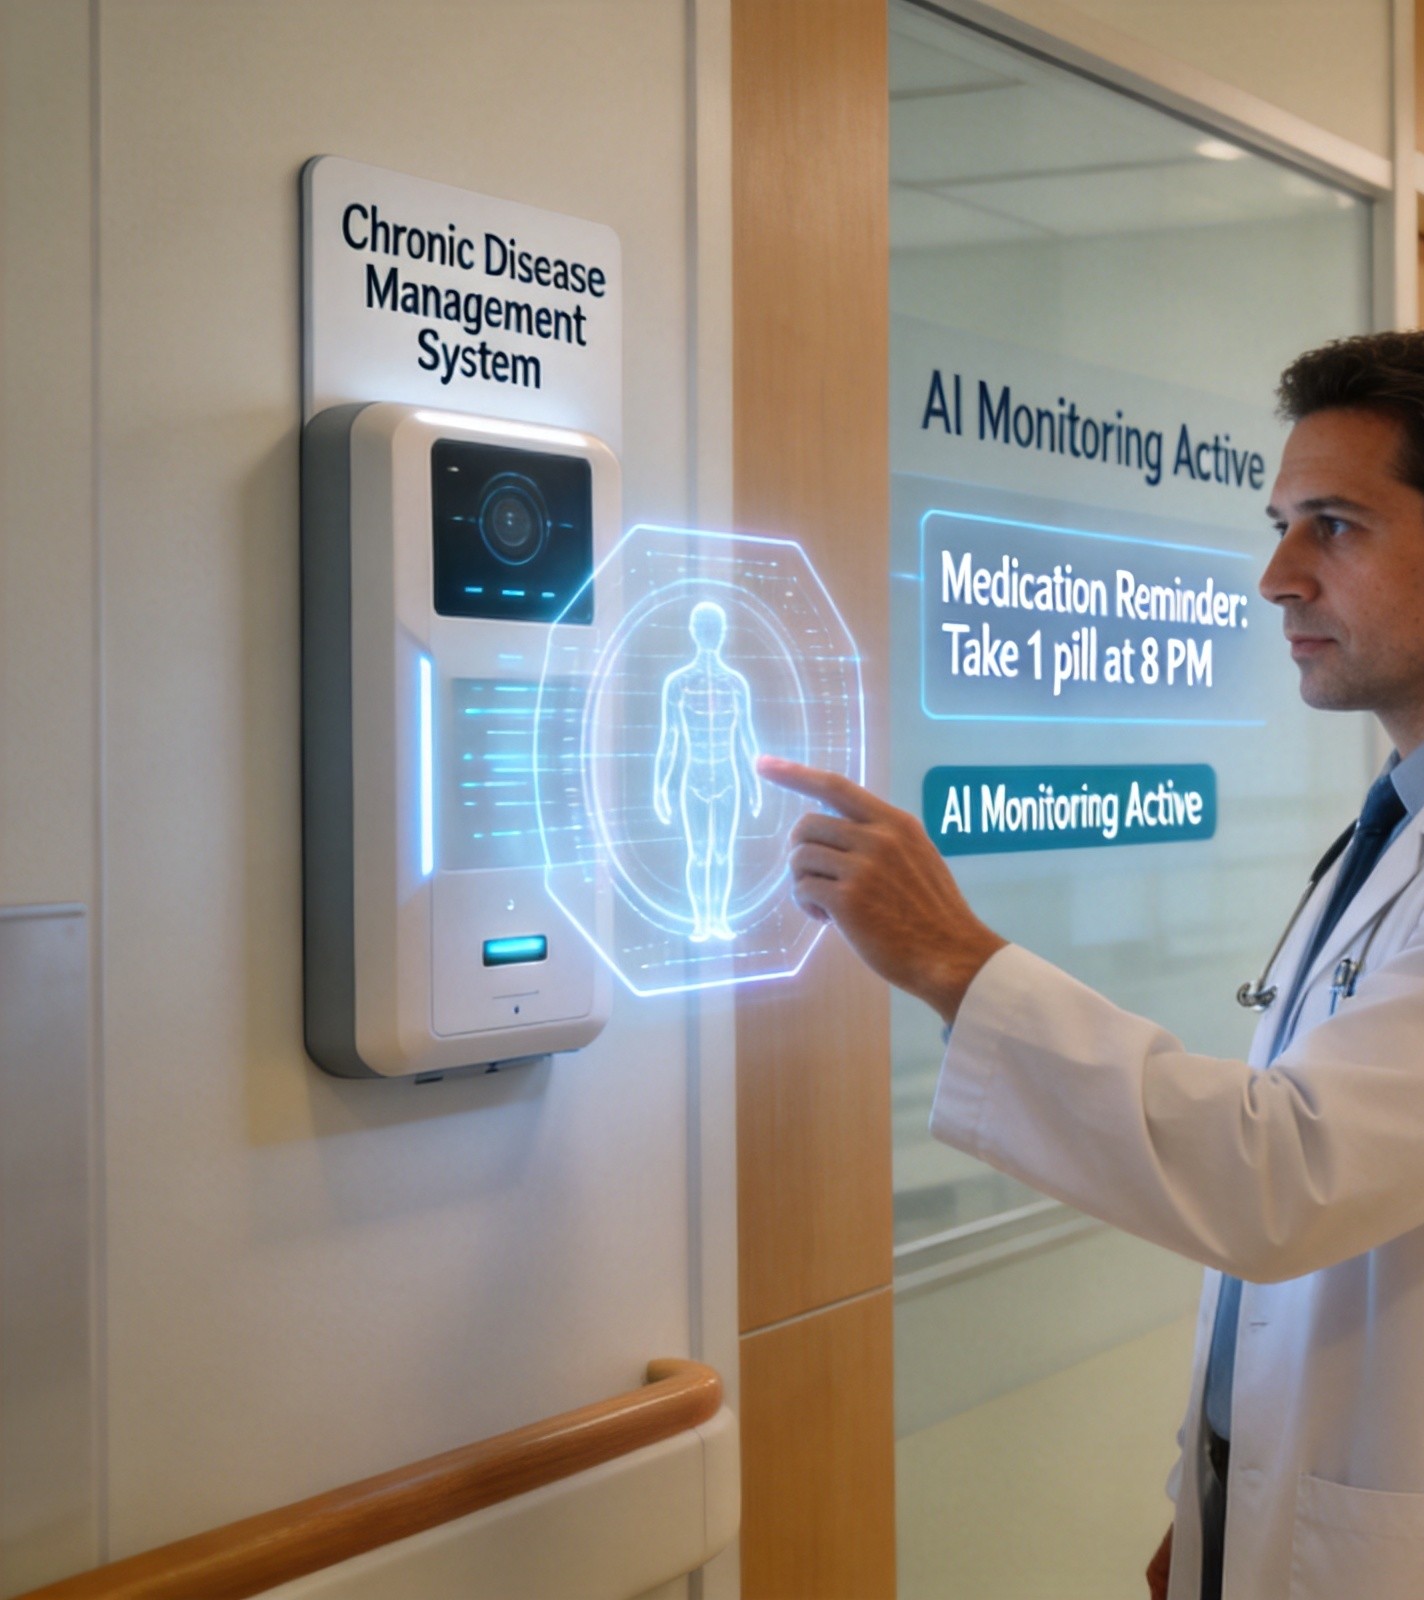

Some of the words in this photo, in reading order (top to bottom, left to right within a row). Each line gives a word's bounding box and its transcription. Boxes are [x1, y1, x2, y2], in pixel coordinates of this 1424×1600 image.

[342, 203, 475, 270] Chronic
[484, 233, 606, 298] Disease
[364, 264, 588, 346] Management
[417, 328, 542, 389] System
[922, 370, 962, 436] AI
[978, 380, 1163, 486] Monitoring
[1173, 423, 1265, 490] Active
[941, 550, 1108, 617] Medication
[1116, 569, 1248, 628] Reminder:
[942, 623, 1019, 679] Take
[1027, 630, 1042, 680] 1
[1053, 627, 1097, 695] pill
[1104, 640, 1135, 683] at
[1141, 637, 1159, 685] 8
[1167, 638, 1213, 688] PM
[941, 786, 971, 835] AI
[981, 783, 1119, 838] Monitoring
[1125, 780, 1203, 828] Active
